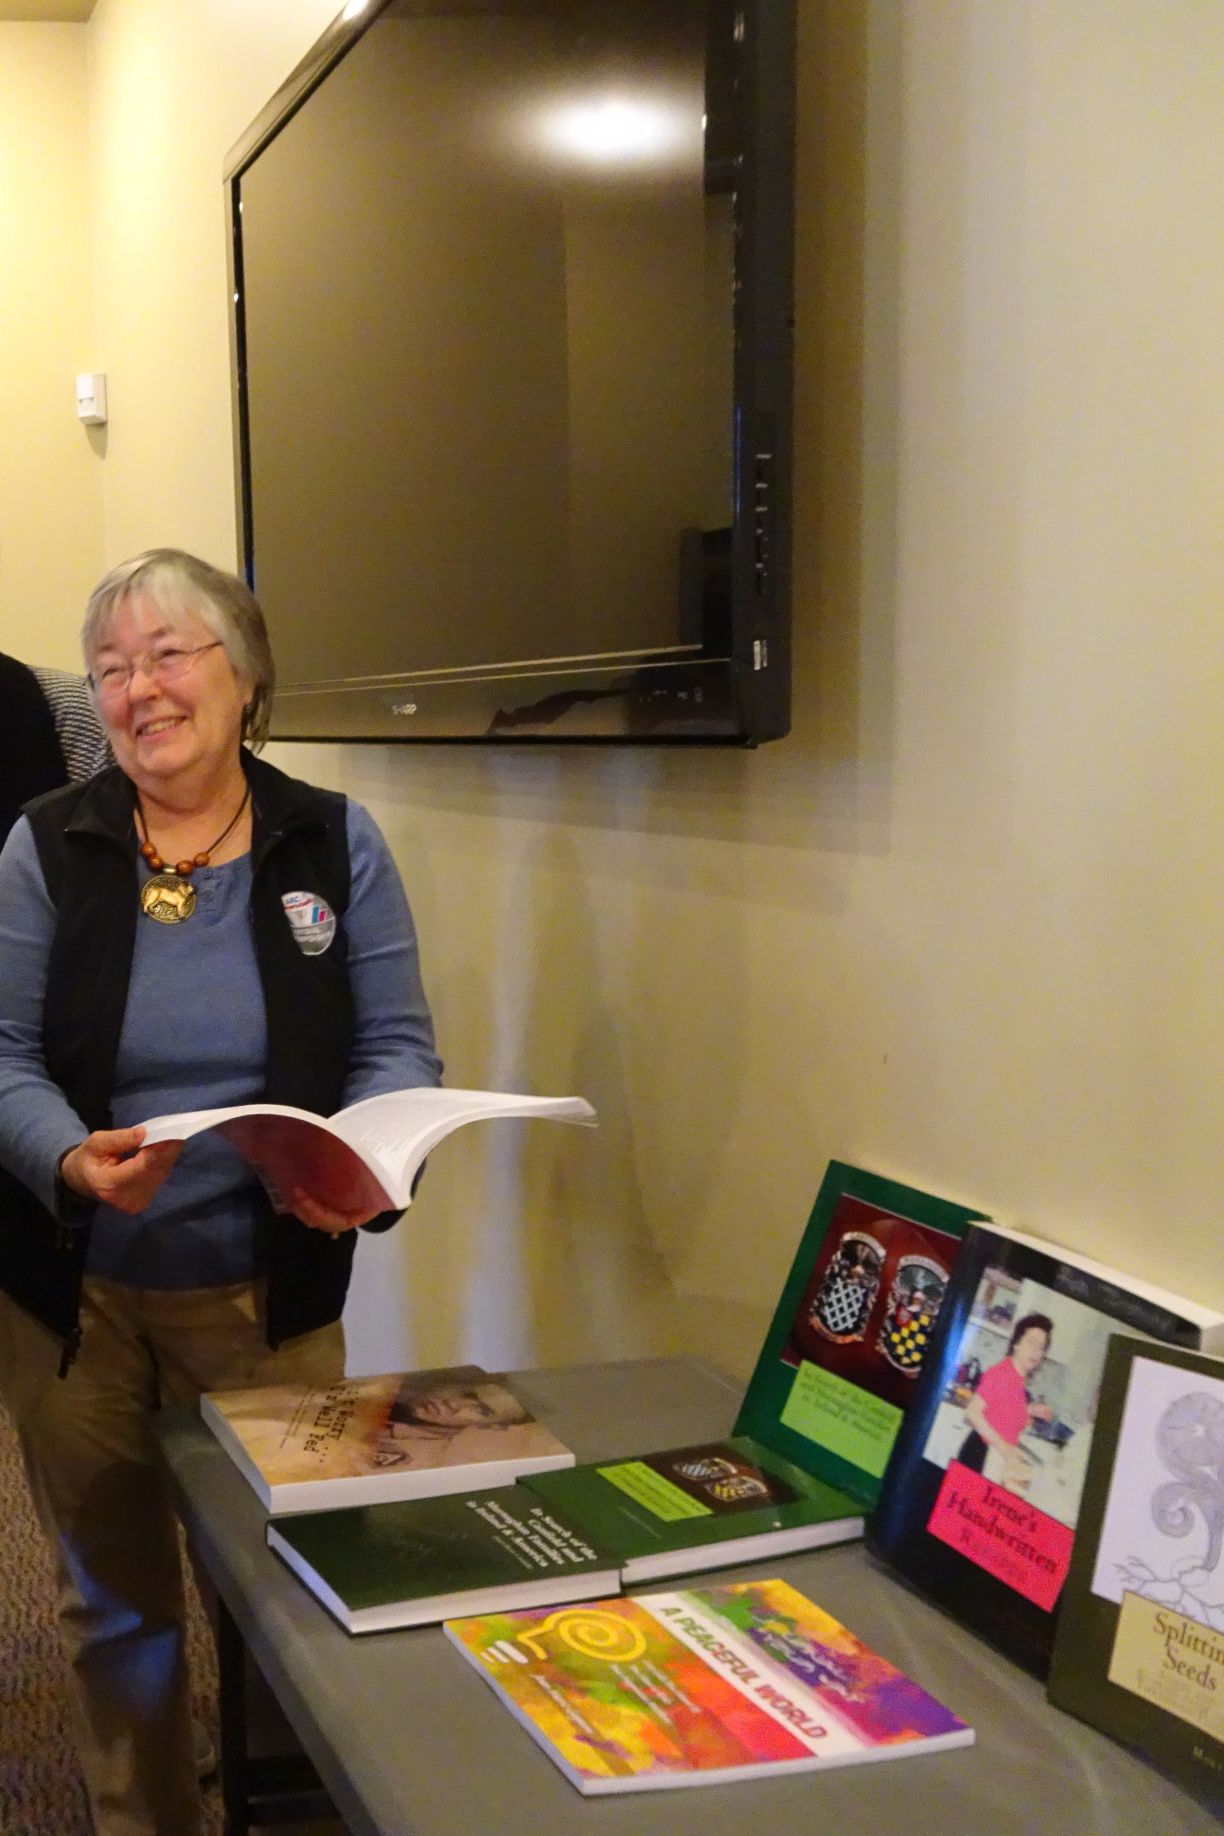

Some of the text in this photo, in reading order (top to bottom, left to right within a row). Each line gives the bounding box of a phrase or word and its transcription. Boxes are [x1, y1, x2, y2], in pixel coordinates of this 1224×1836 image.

[661, 1607, 682, 1617] A
[674, 1617, 760, 1684] PEACEFUL
[755, 1685, 829, 1739] WORLD
[1163, 1645, 1216, 1691] Seeds
